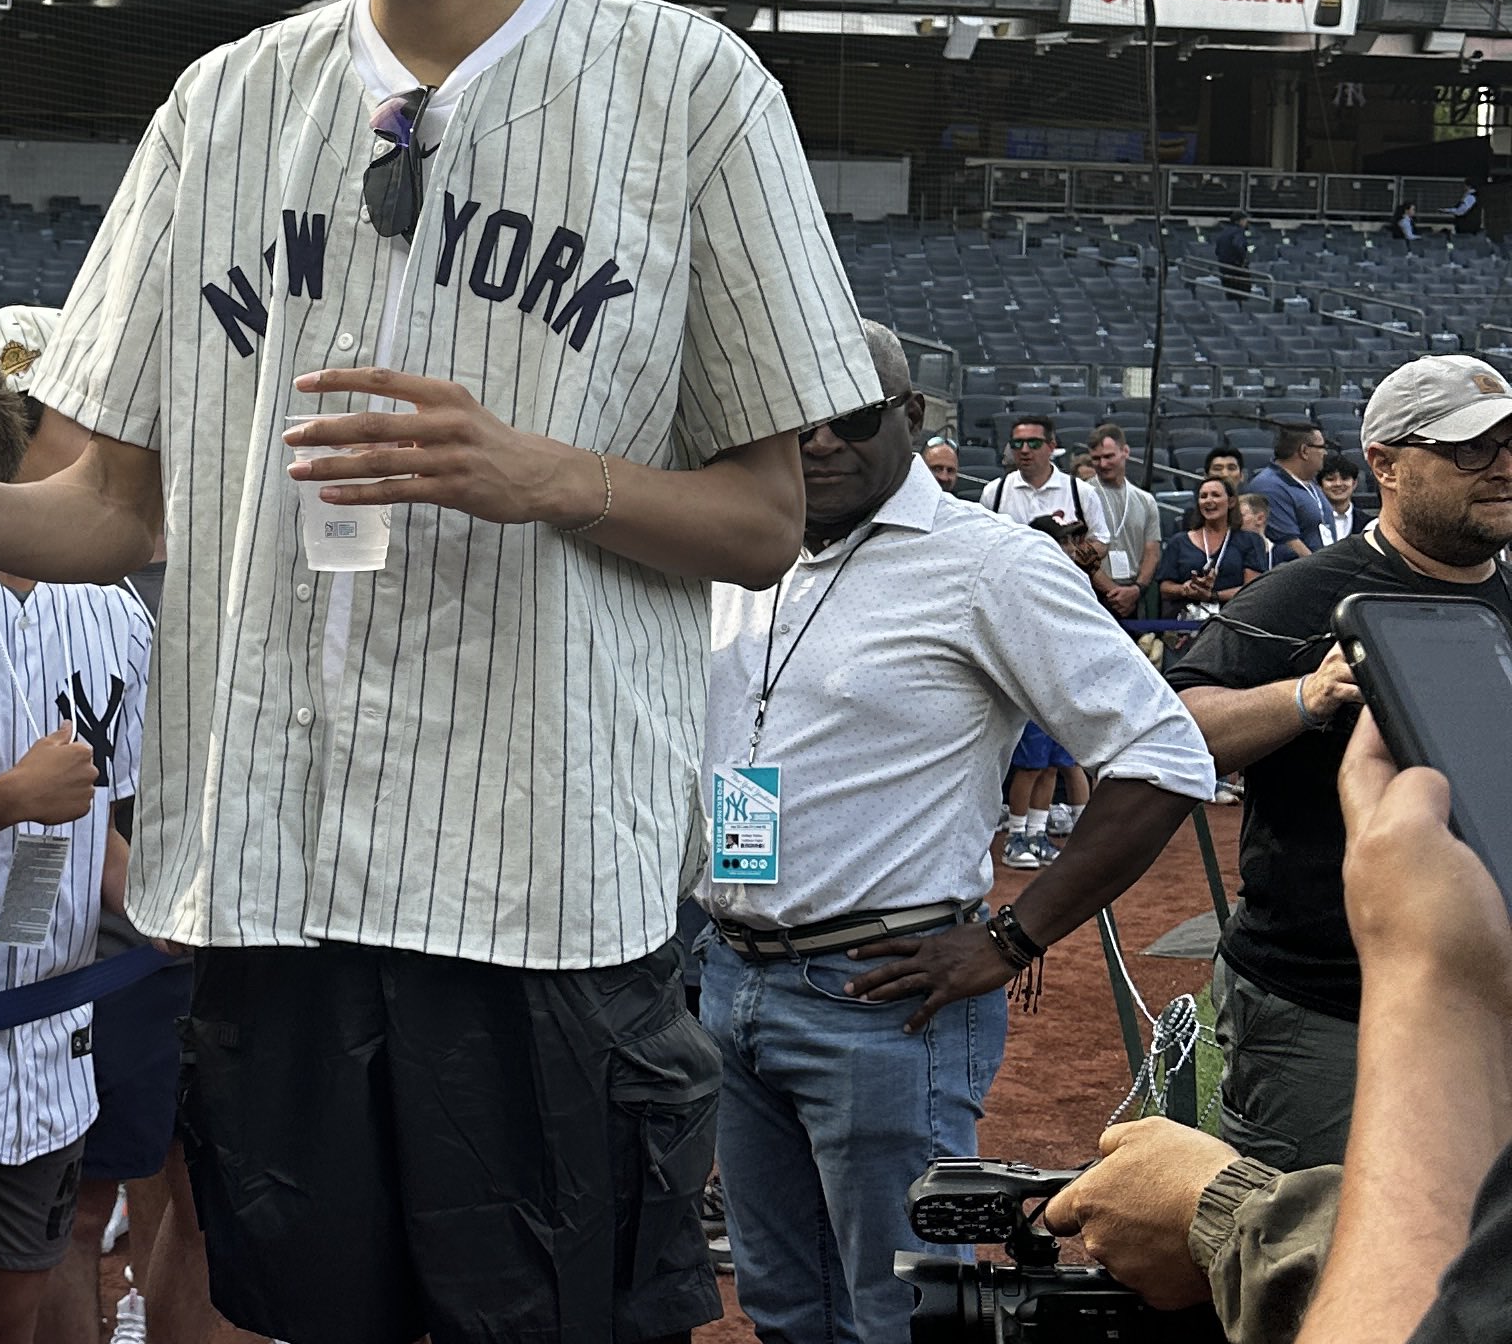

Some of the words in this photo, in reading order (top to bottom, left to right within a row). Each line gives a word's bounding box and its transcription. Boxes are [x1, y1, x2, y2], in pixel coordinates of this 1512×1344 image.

[201, 209, 326, 358] NW
[435, 191, 635, 353] YORK
[724, 791, 748, 821] NY
